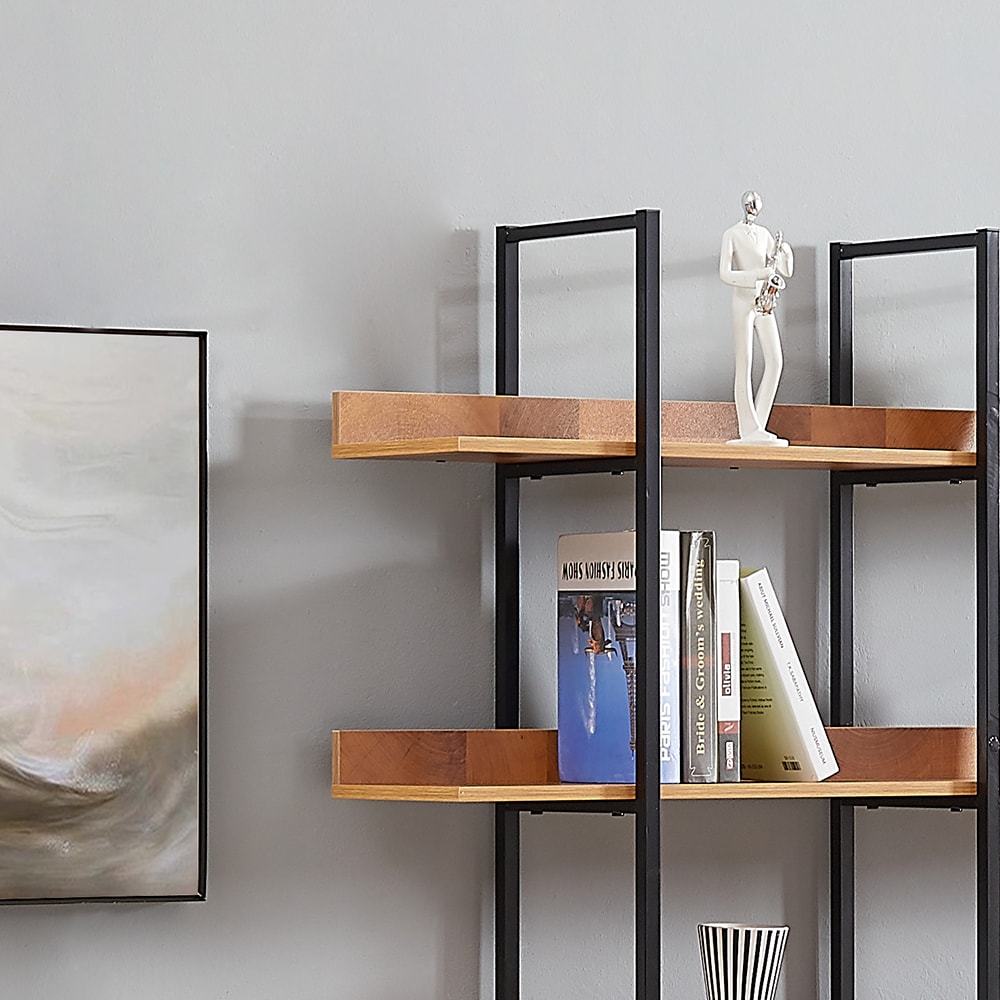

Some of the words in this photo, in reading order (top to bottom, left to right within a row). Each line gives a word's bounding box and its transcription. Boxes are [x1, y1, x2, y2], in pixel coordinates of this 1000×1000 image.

[617, 561, 634, 580] ARIS
[694, 559, 705, 620] wedding
[695, 695, 705, 709] &
[695, 714, 705, 754] Bride
